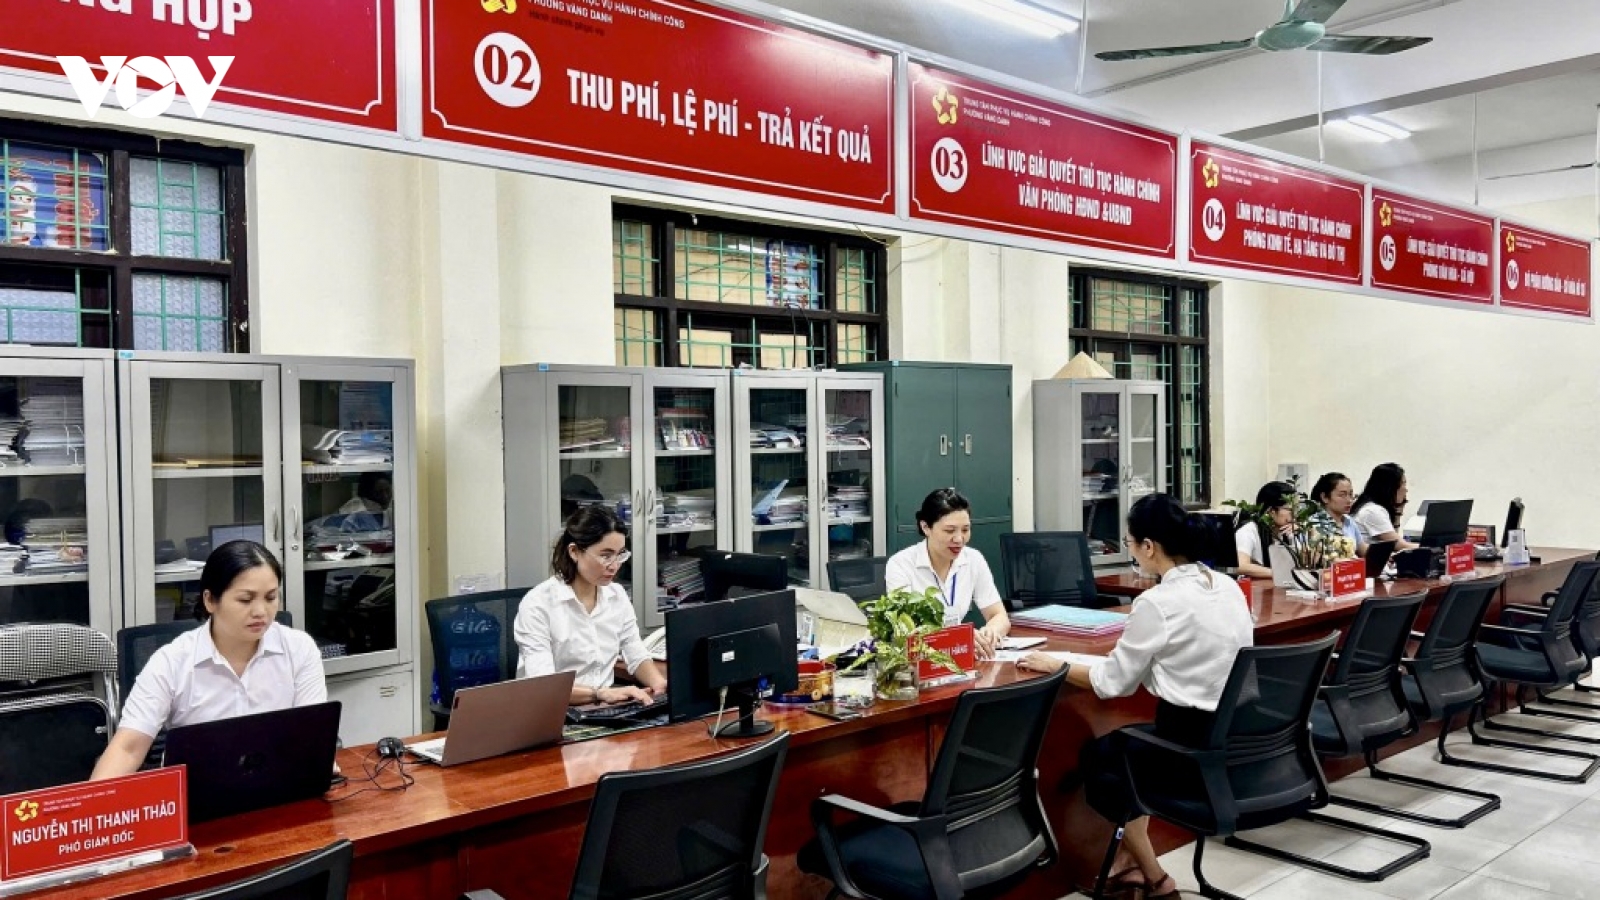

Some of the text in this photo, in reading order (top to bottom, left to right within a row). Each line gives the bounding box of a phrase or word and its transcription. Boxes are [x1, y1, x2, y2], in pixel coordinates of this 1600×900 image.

[590, 9, 613, 24] DANH
[614, 2, 637, 17] HÀNH
[638, 8, 663, 23] CHÍNH
[664, 14, 685, 28] CÔNG
[481, 44, 536, 93] 02
[567, 68, 613, 112] THU
[621, 81, 667, 128] PHÍ,
[673, 88, 698, 136] LỆ
[704, 98, 738, 137] PHÍ
[757, 106, 795, 148] TRẢ
[800, 115, 832, 156] KẾT
[838, 124, 872, 164] QUẢ
[935, 146, 966, 180] 03
[982, 140, 1161, 204] LĨNH VỰC GIẢI QUYẾT THỦ TỤC HÀNH CHÍNH
[1018, 181, 1039, 209] VĂN
[1041, 185, 1073, 215] PHÒNG
[1205, 205, 1224, 232] 04
[1382, 241, 1395, 262] 05
[12, 818, 68, 846] NGUYỄN
[72, 816, 93, 835] THỊ
[96, 807, 140, 830] THANH
[143, 799, 176, 821] THẢO
[58, 828, 135, 855] PHÓ GIÁM ĐỐC
